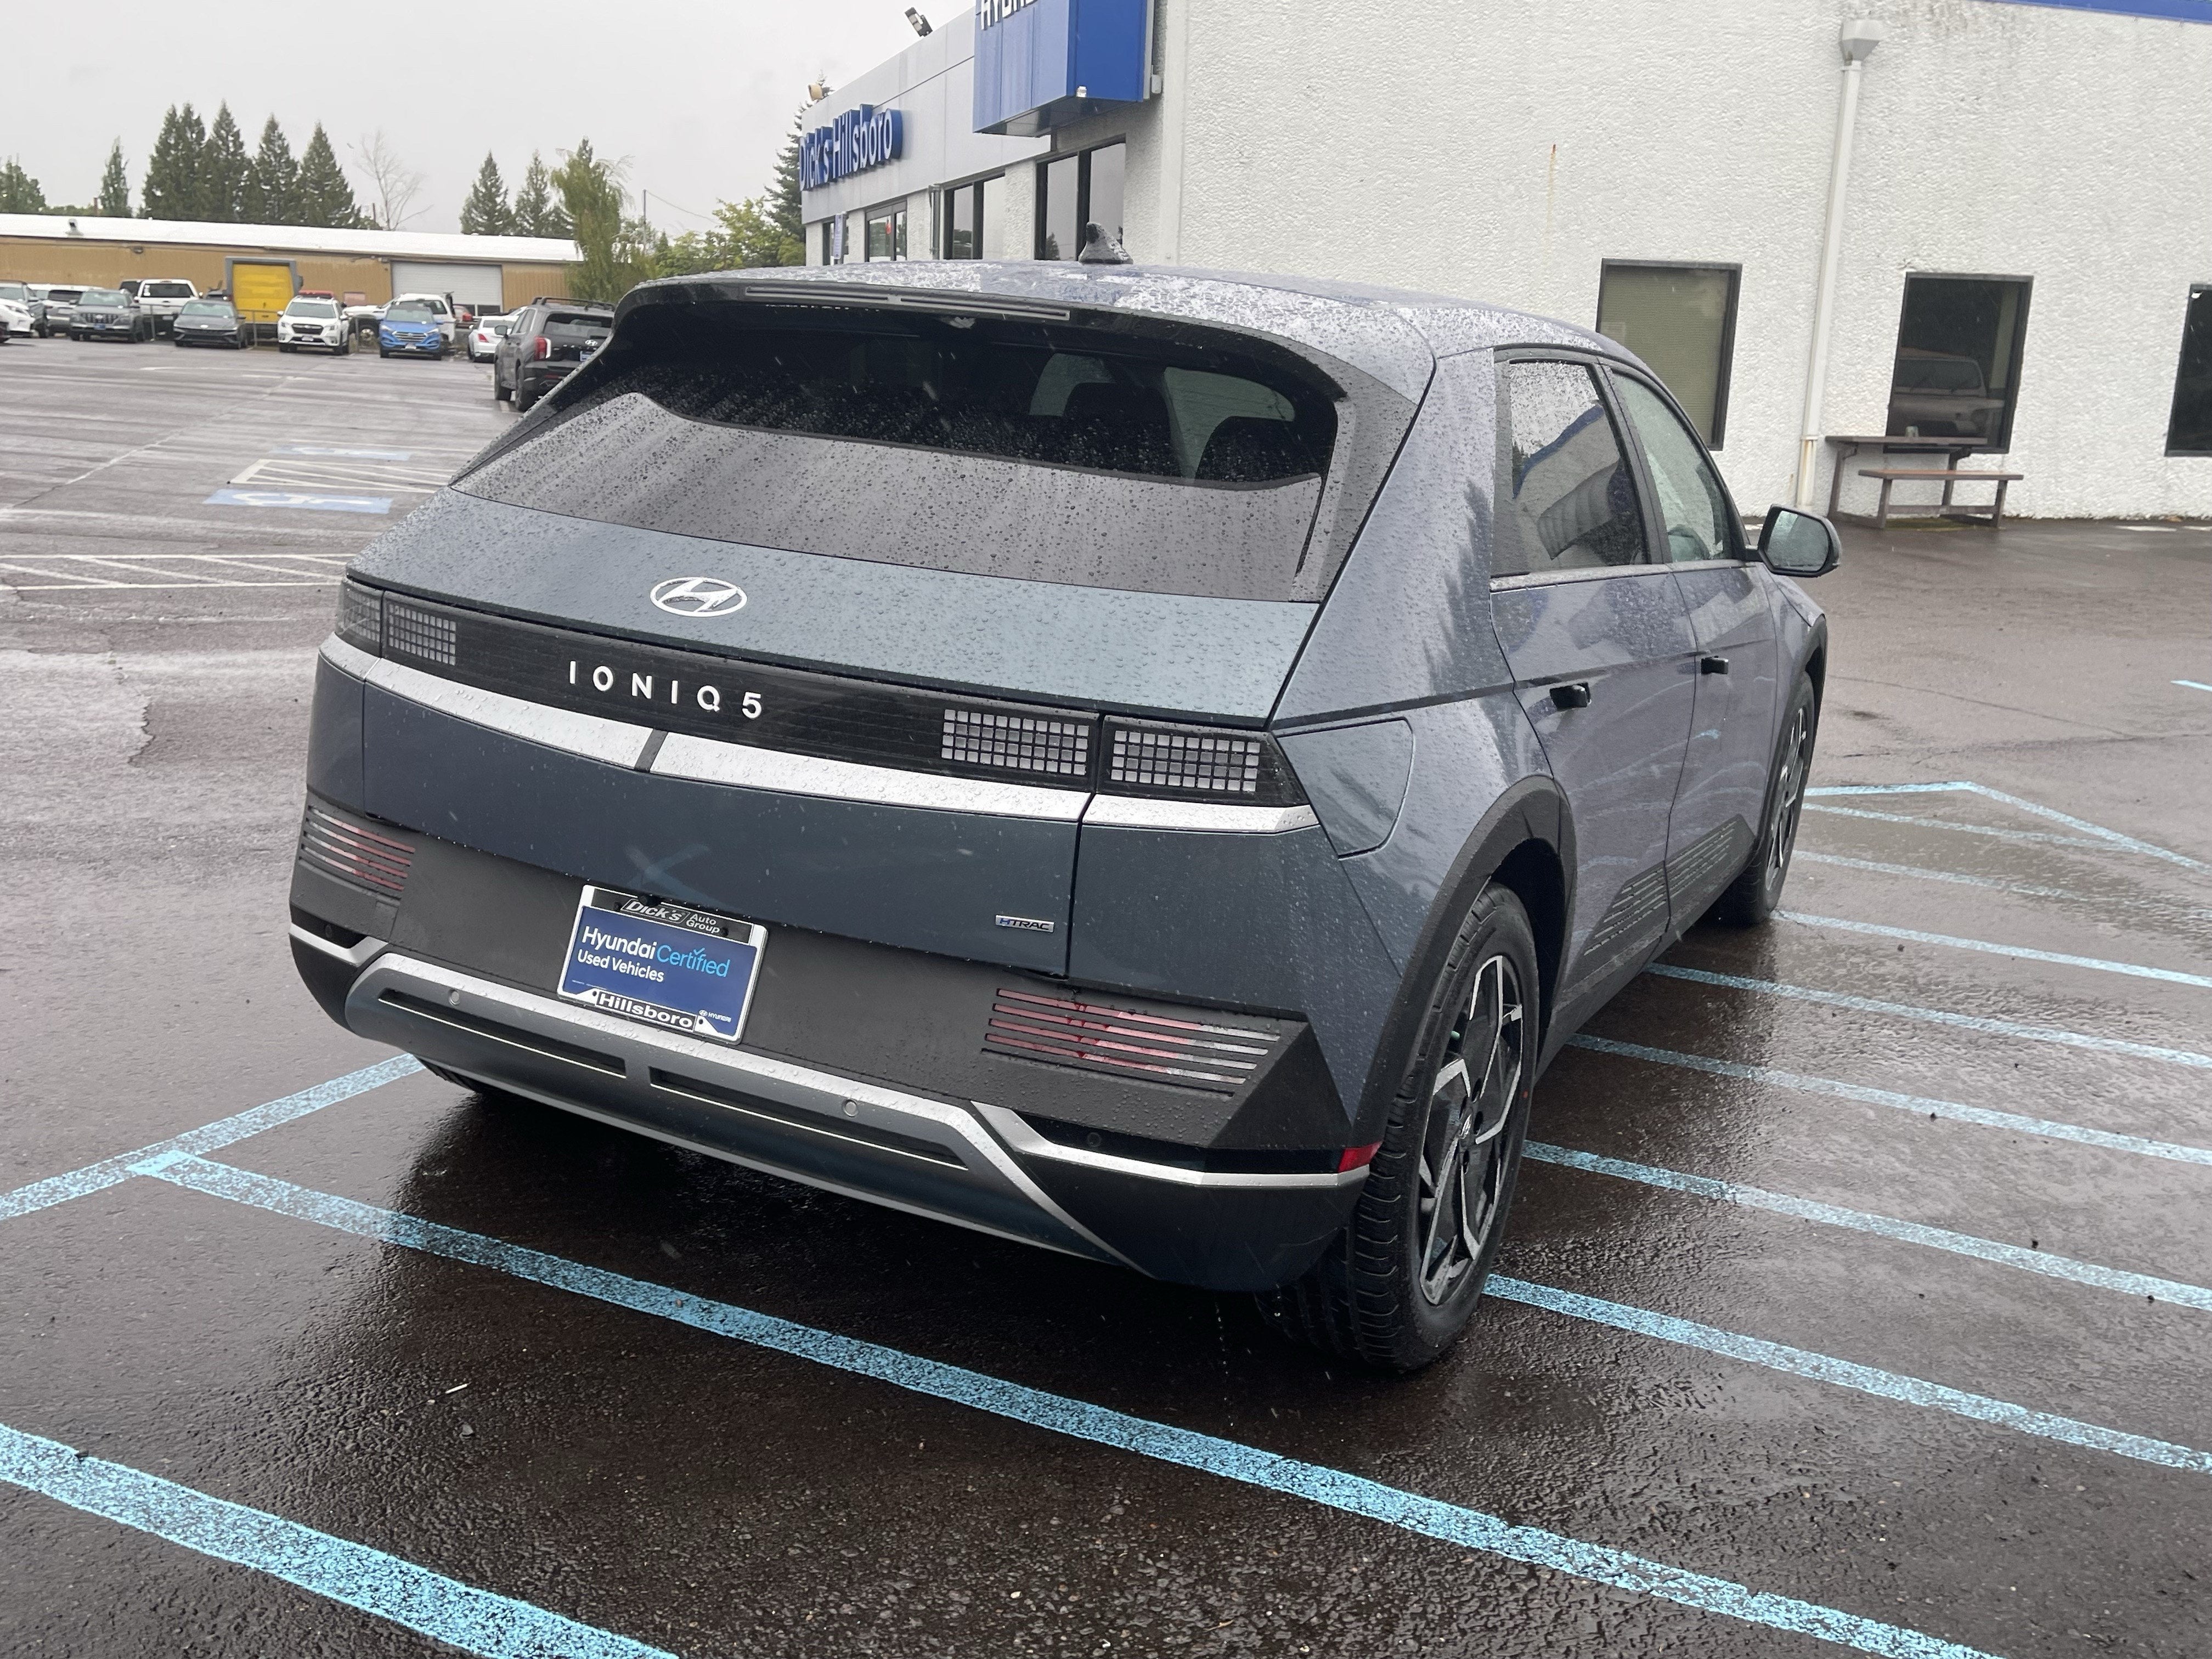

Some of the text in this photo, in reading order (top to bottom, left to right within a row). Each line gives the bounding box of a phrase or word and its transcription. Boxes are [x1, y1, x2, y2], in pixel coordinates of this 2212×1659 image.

[799, 104, 894, 191] Dick's Hillsboro
[569, 660, 762, 719] IONIQ 5
[686, 919, 720, 934] Group
[689, 913, 716, 926] Auto
[998, 918, 1050, 930] HTRAC
[577, 949, 665, 983] Used Vehicles
[582, 925, 731, 978] Hyundai Certified
[600, 992, 693, 1029] Hillsboro
